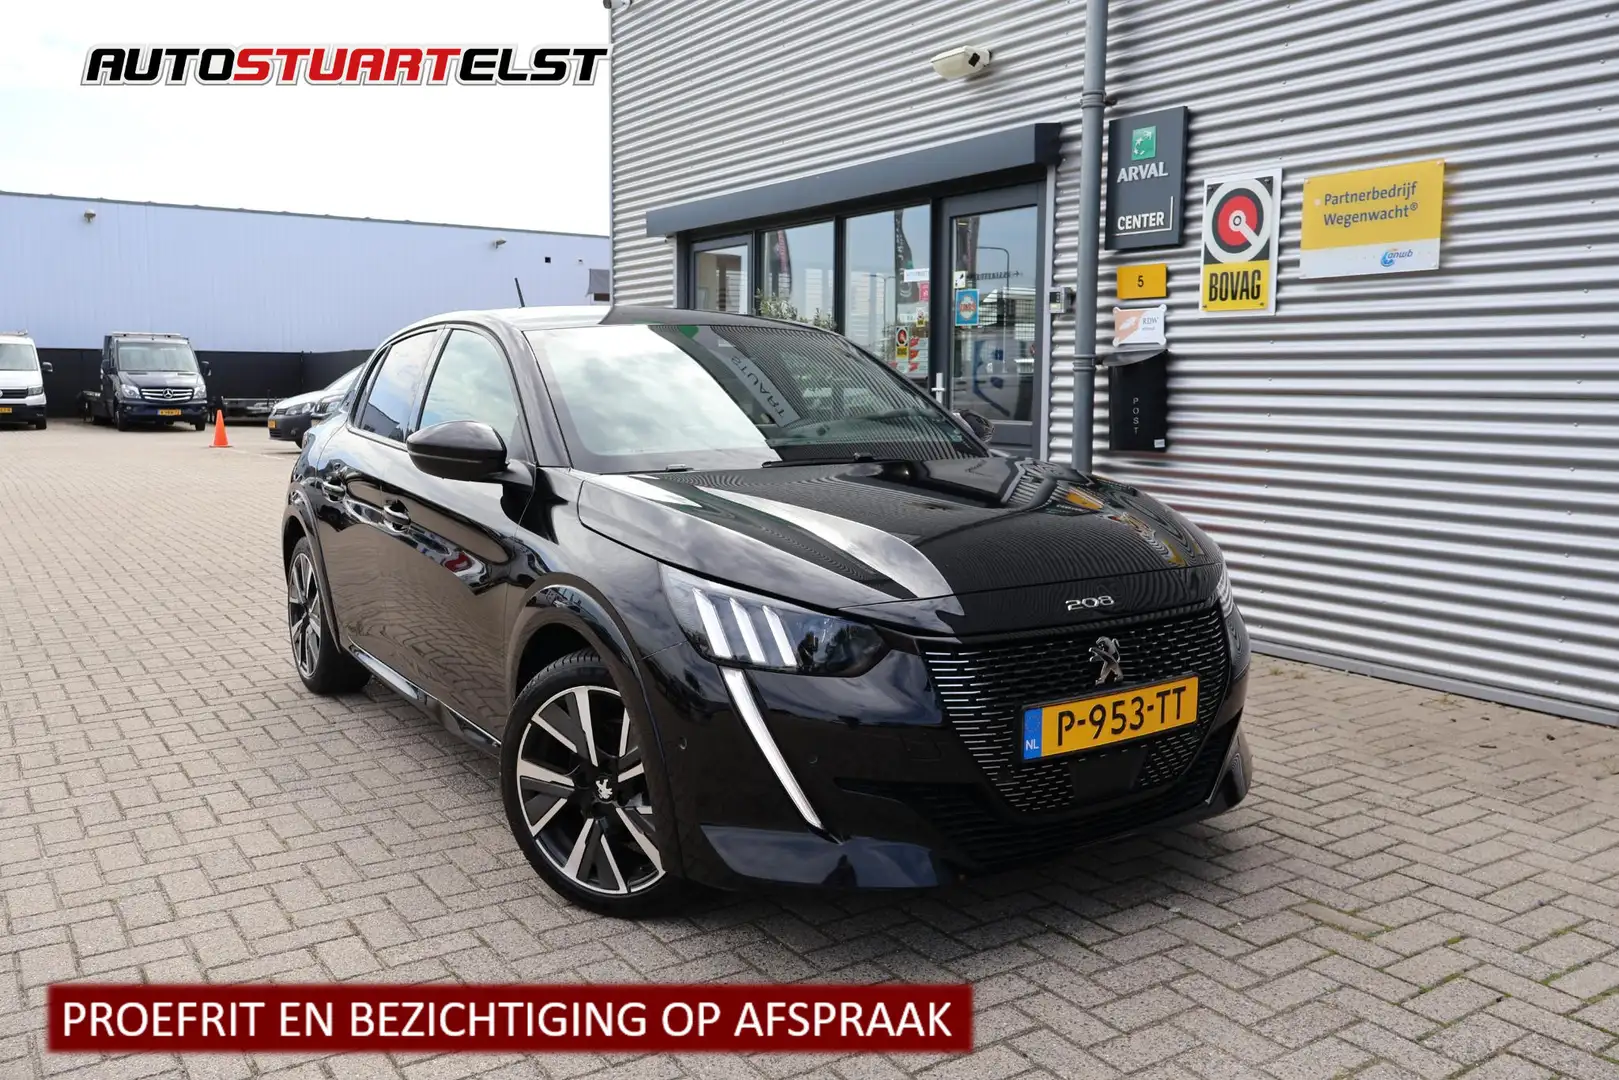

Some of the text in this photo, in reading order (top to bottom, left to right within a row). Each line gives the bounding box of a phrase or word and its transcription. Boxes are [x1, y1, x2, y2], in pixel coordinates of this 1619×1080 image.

[1117, 161, 1169, 183] ARVAL
[1324, 180, 1418, 206] Partnerbedrijf
[1117, 211, 1165, 230] CENTER
[1137, 274, 1145, 288] 5
[1208, 269, 1262, 302] BOVAG
[1132, 397, 1140, 435] POST
[1065, 595, 1115, 611] 208
[1057, 686, 1187, 746] P-953-TT
[1025, 739, 1040, 750] NL
